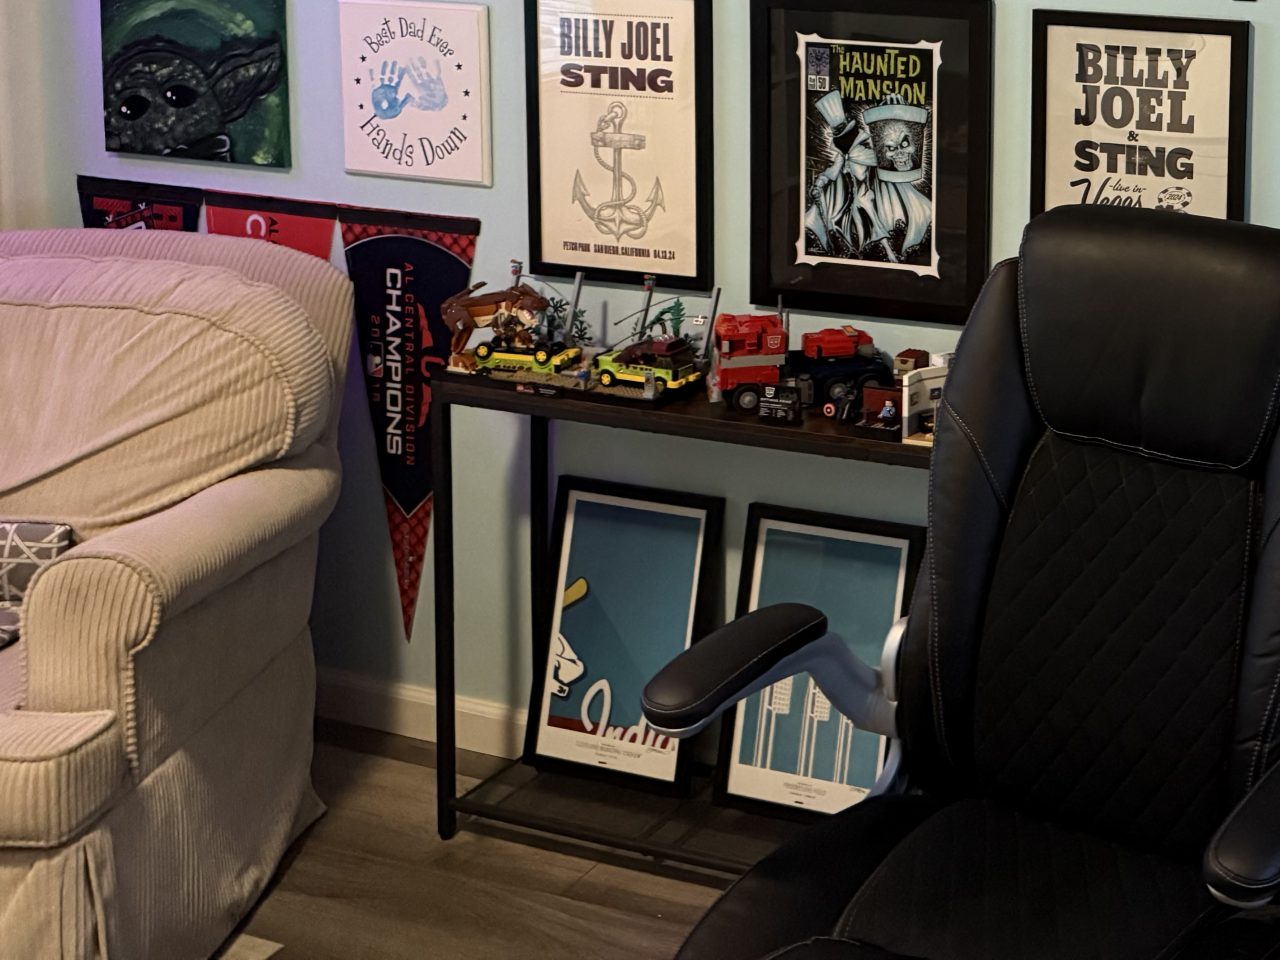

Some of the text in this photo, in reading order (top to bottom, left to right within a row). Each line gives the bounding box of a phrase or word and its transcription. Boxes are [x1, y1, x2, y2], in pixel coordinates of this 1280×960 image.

[363, 17, 454, 57] Best Dad Ever
[560, 16, 673, 62] BILLY JOEL
[830, 44, 845, 54] The
[560, 63, 674, 94] STING
[840, 49, 920, 78] HAUNTED
[1075, 42, 1196, 90] BILLY
[818, 77, 826, 90] 50
[838, 76, 926, 104] MANSION
[1074, 85, 1194, 134] JOEL
[360, 114, 467, 167] Hands Down
[1127, 131, 1139, 142] &
[1074, 140, 1194, 180] STING
[1166, 193, 1183, 201] 2024
[594, 244, 604, 254] SAN
[621, 246, 650, 258] CALIFORNIA
[386, 268, 402, 455] CHAMPIONS
[404, 262, 416, 466] AL CENTRAL DIVISION
